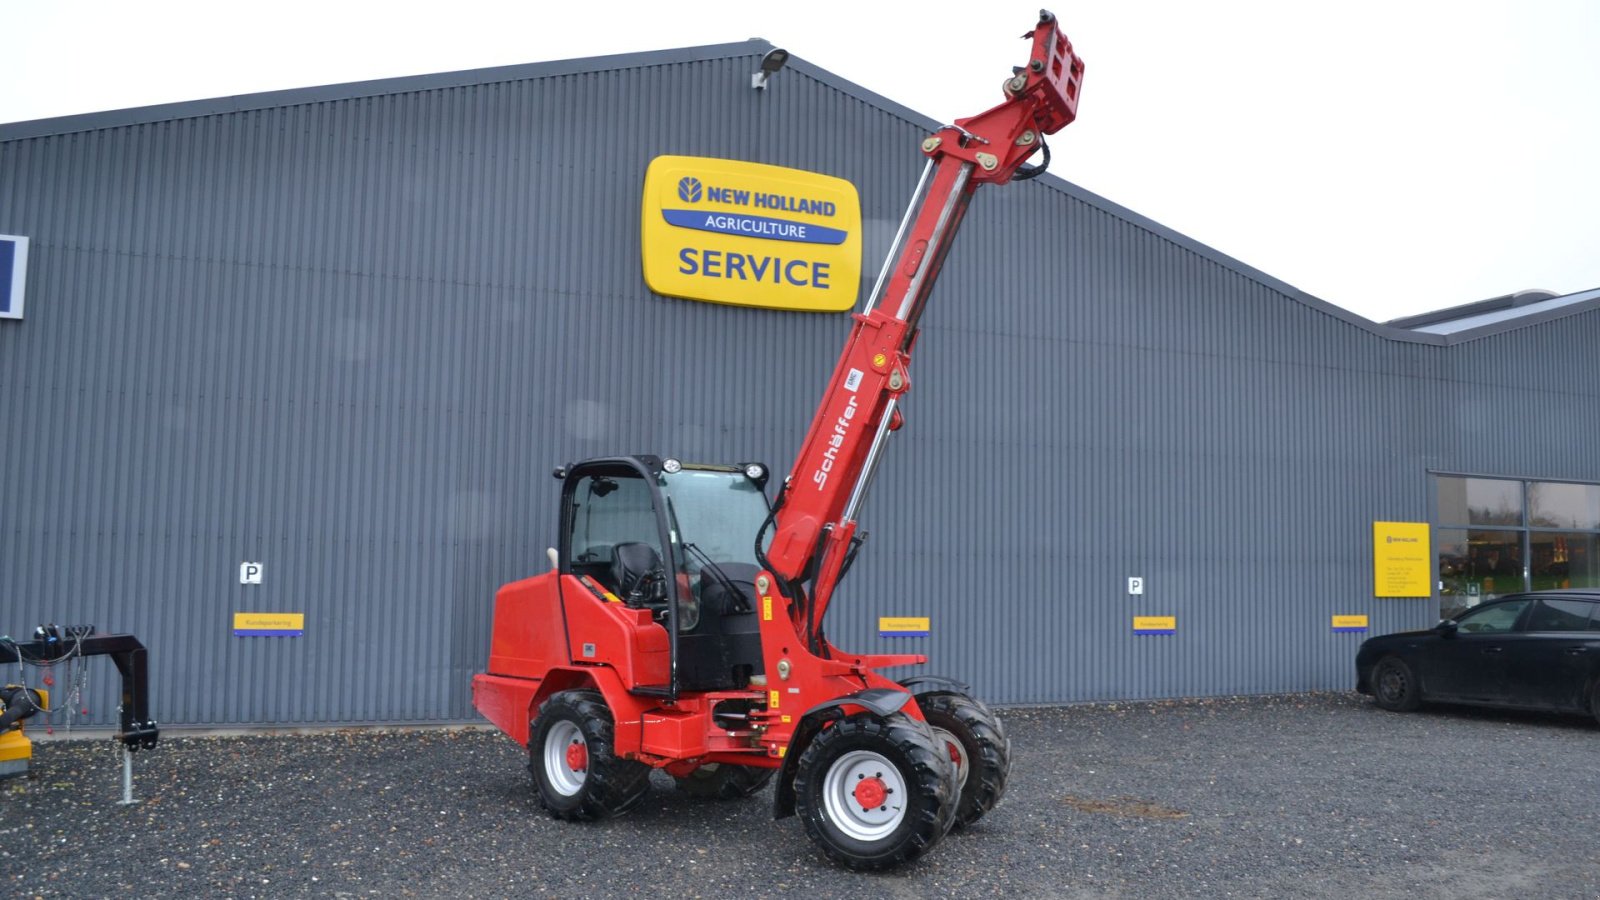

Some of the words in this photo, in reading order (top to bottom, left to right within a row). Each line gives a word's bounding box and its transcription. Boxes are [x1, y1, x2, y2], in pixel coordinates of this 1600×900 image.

[707, 186, 750, 206] NEW
[754, 192, 836, 217] HOLLAND
[705, 215, 806, 238] AGRICULTURE
[678, 248, 830, 289] SERVICE
[813, 395, 859, 491] Schäffer
[246, 565, 258, 580] P
[1132, 580, 1140, 592] P
